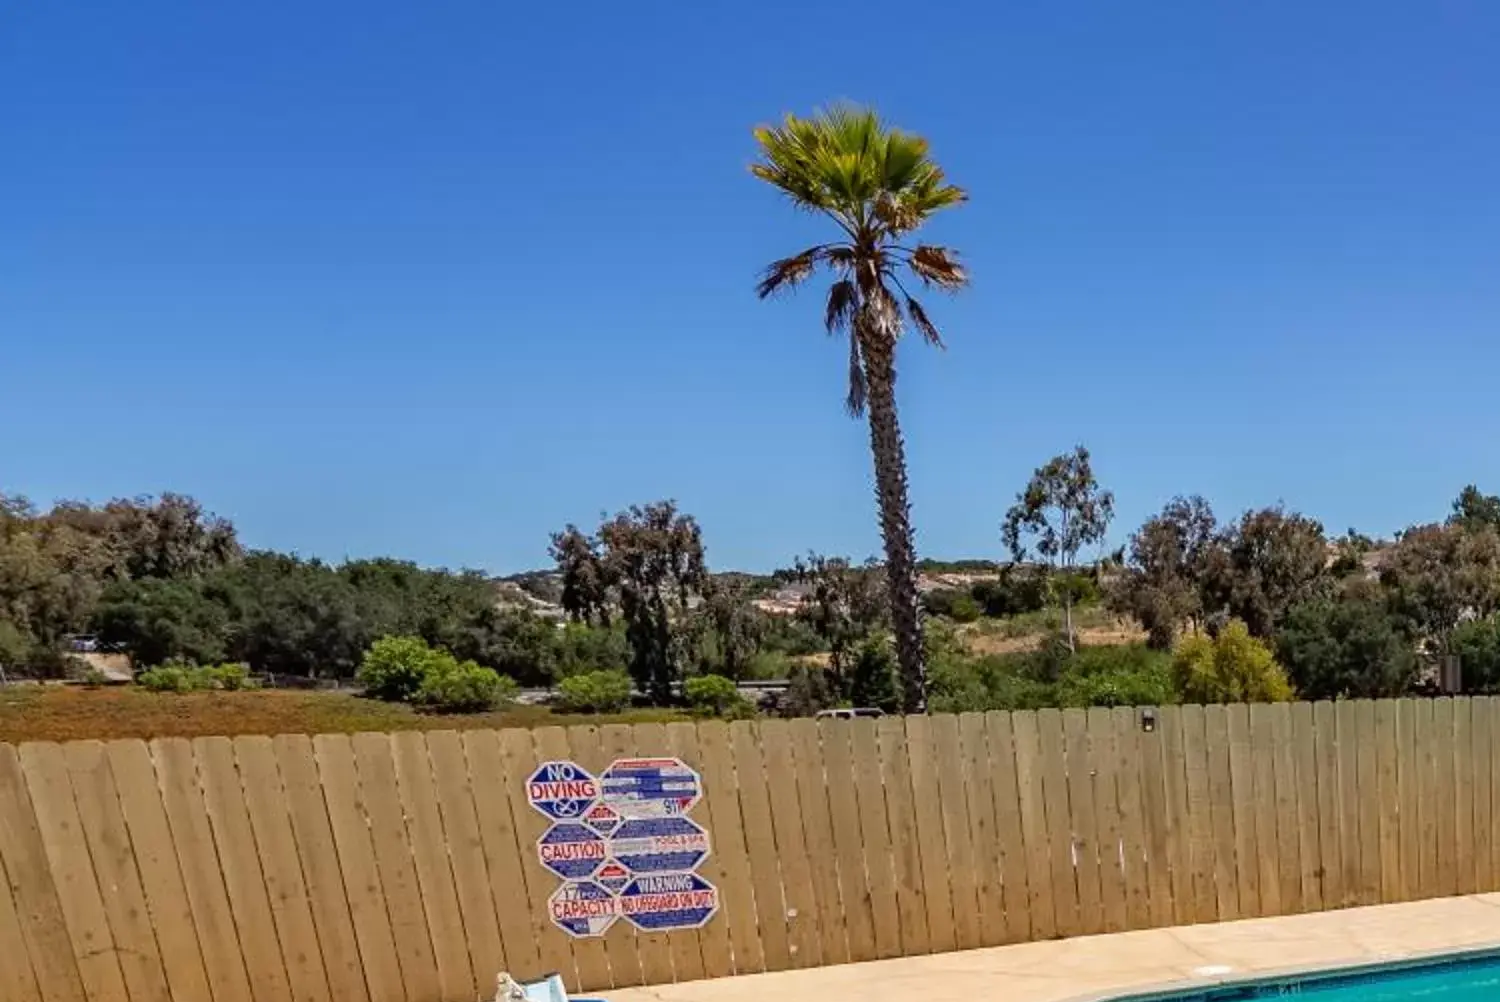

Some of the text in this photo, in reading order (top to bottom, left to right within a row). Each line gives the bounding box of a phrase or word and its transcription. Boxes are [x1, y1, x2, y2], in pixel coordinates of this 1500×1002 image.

[548, 764, 575, 781] NO
[530, 781, 597, 799] DIVING
[541, 842, 605, 860] CAUTION
[637, 875, 693, 893] WARNING
[553, 899, 615, 919] CAPACITY
[622, 891, 715, 912] NO LIFEGUARD ON DUTY
